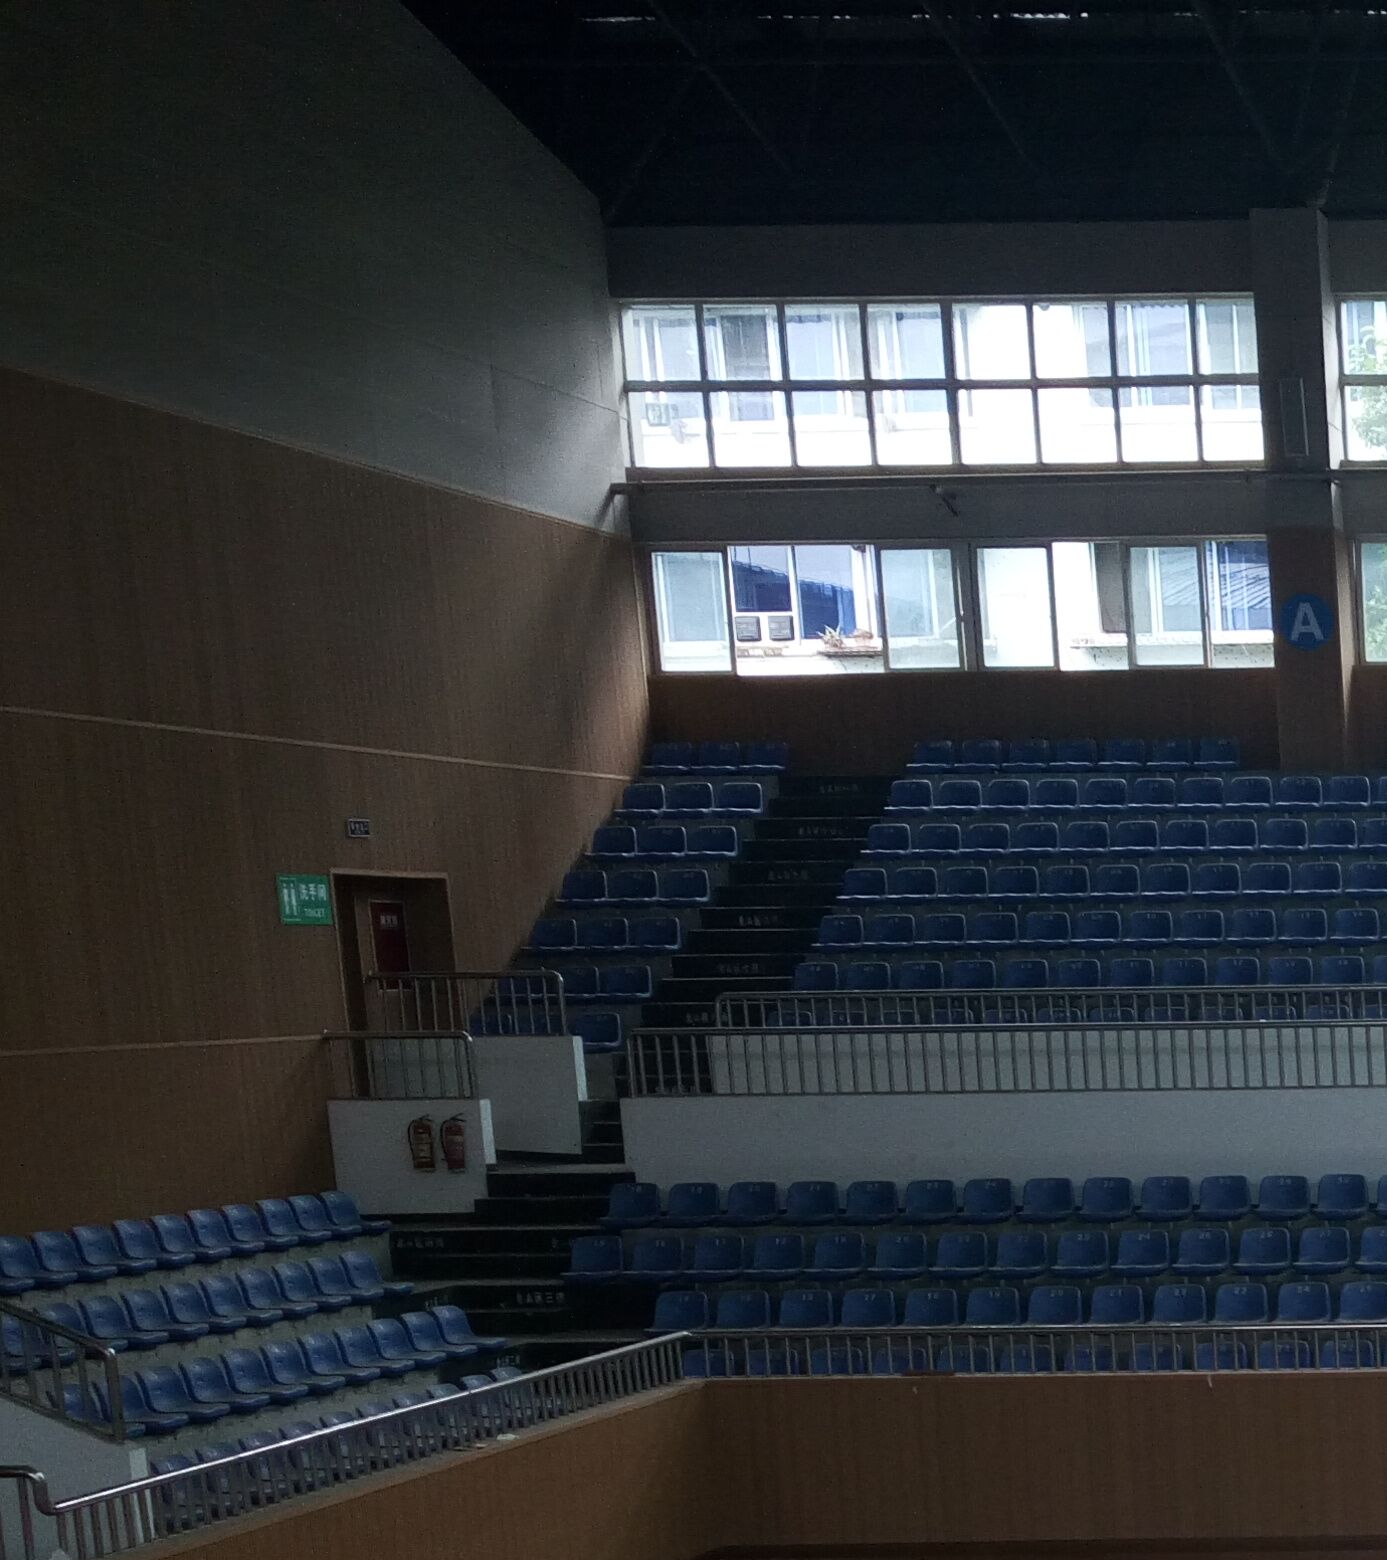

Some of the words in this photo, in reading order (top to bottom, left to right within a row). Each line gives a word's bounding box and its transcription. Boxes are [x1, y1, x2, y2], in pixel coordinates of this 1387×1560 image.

[1291, 602, 1324, 641] A
[298, 882, 327, 901] 洗手间
